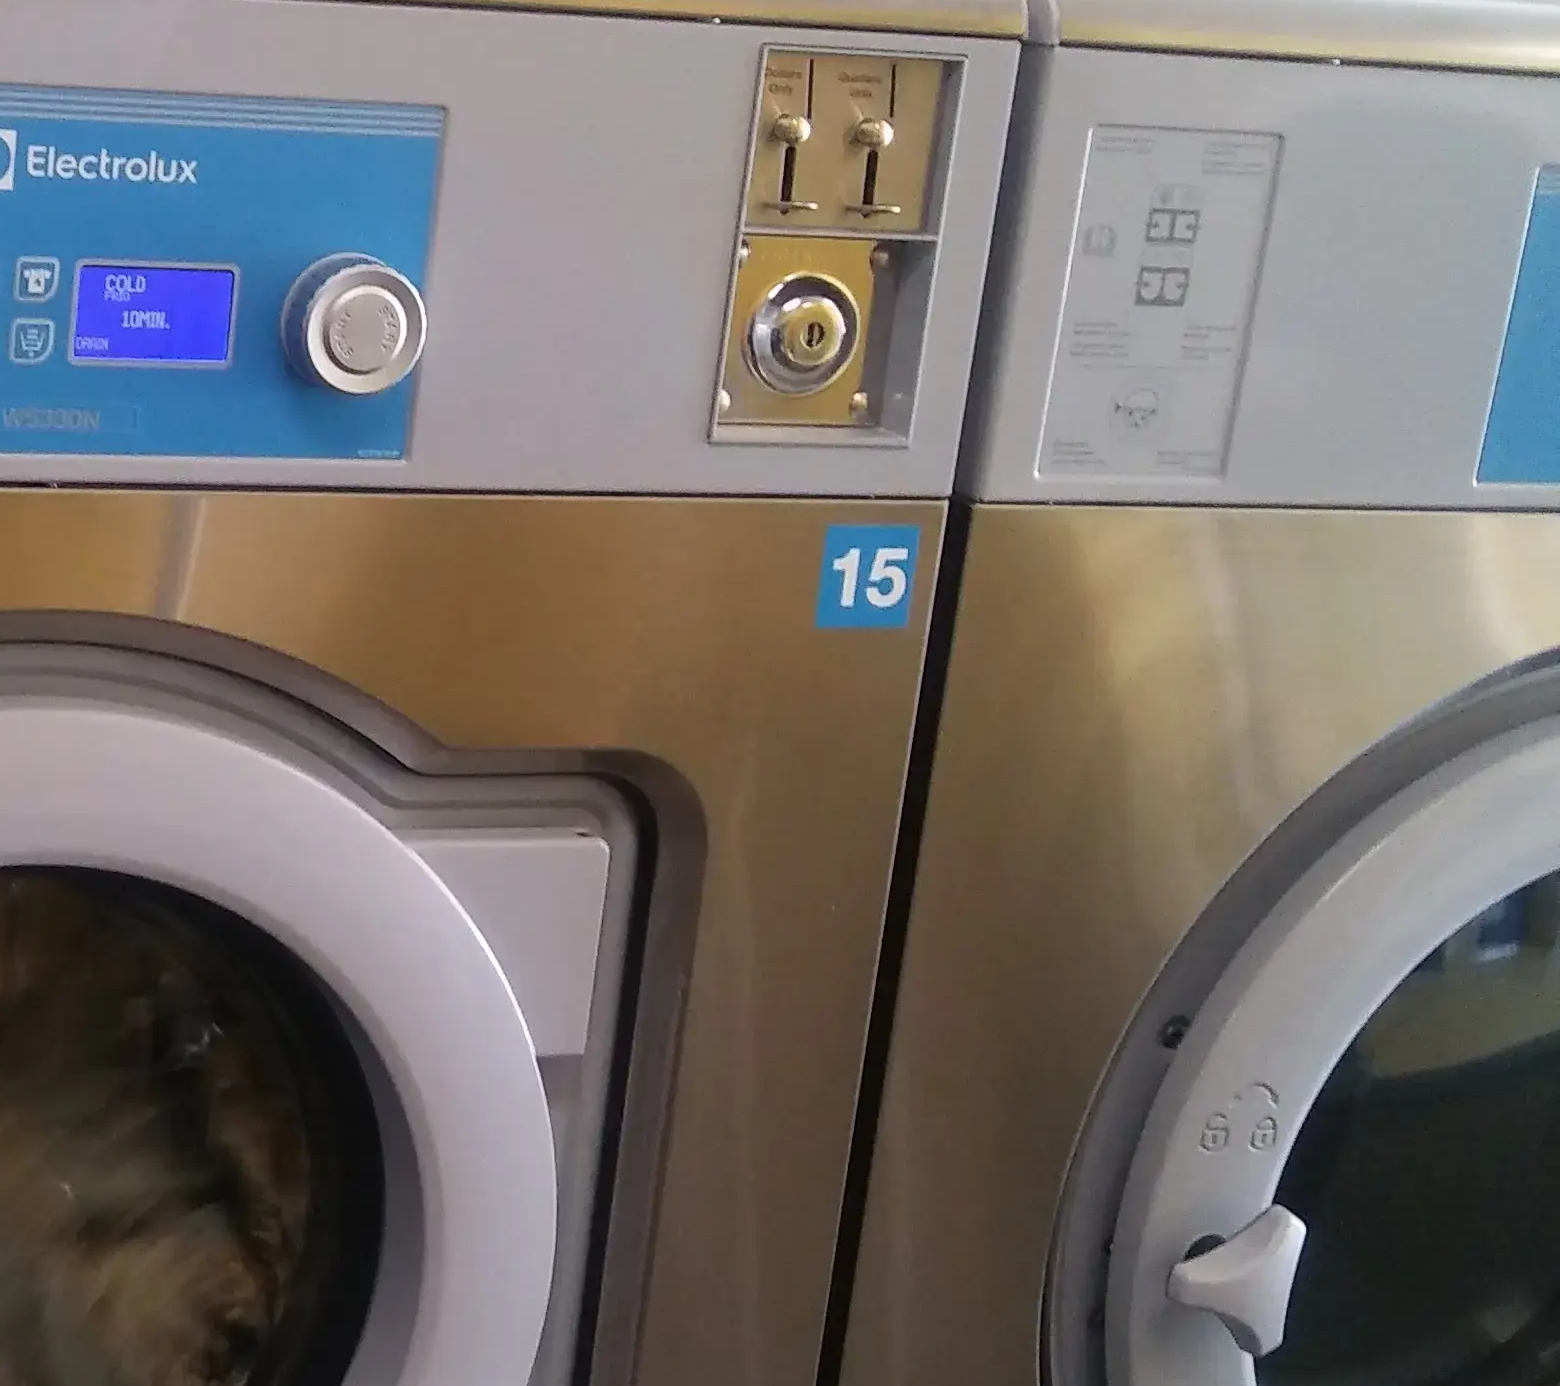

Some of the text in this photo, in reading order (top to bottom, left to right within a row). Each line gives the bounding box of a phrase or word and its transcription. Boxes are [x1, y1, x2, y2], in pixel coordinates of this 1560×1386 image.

[26, 144, 198, 185] Electrolux
[104, 274, 147, 293] COLD
[75, 336, 109, 351] DRAIN
[832, 547, 909, 609] 15
